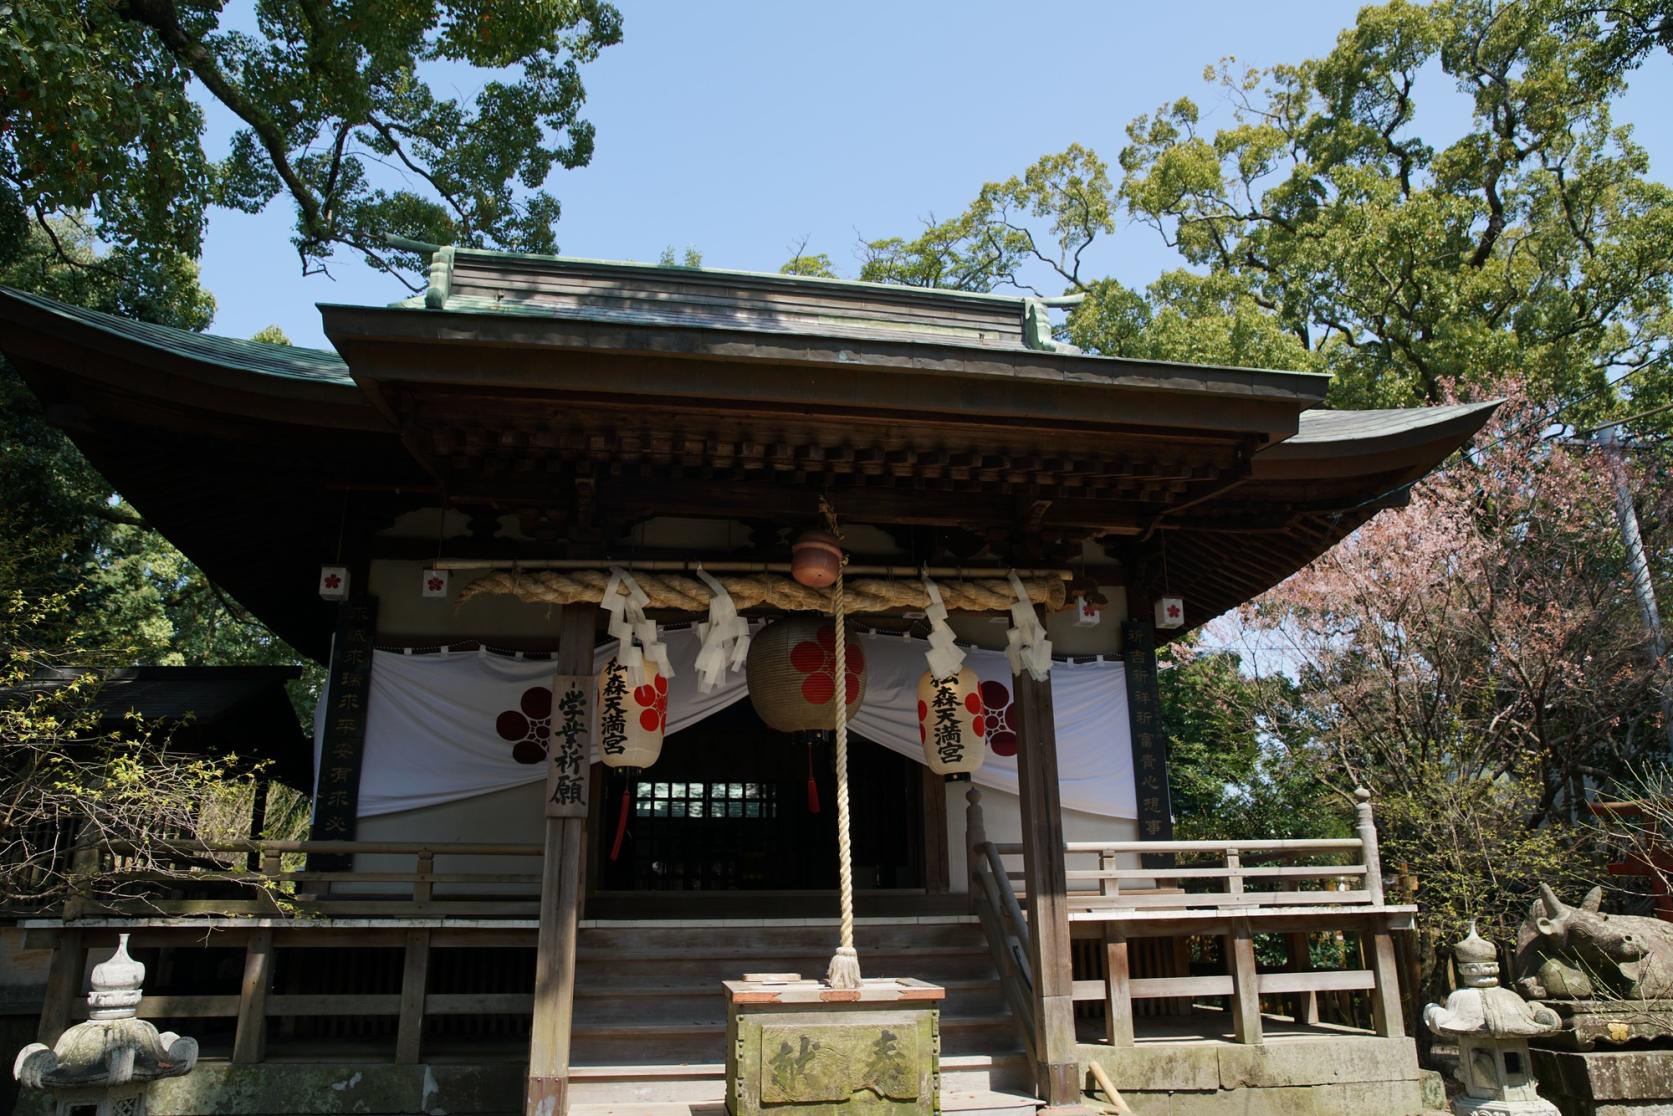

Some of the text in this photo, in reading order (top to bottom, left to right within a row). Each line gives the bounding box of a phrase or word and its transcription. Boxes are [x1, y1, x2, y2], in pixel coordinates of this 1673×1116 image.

[549, 690, 588, 806] 学業祈願
[1128, 630, 1164, 857] 祈吉祈祥祈富貴心想事
